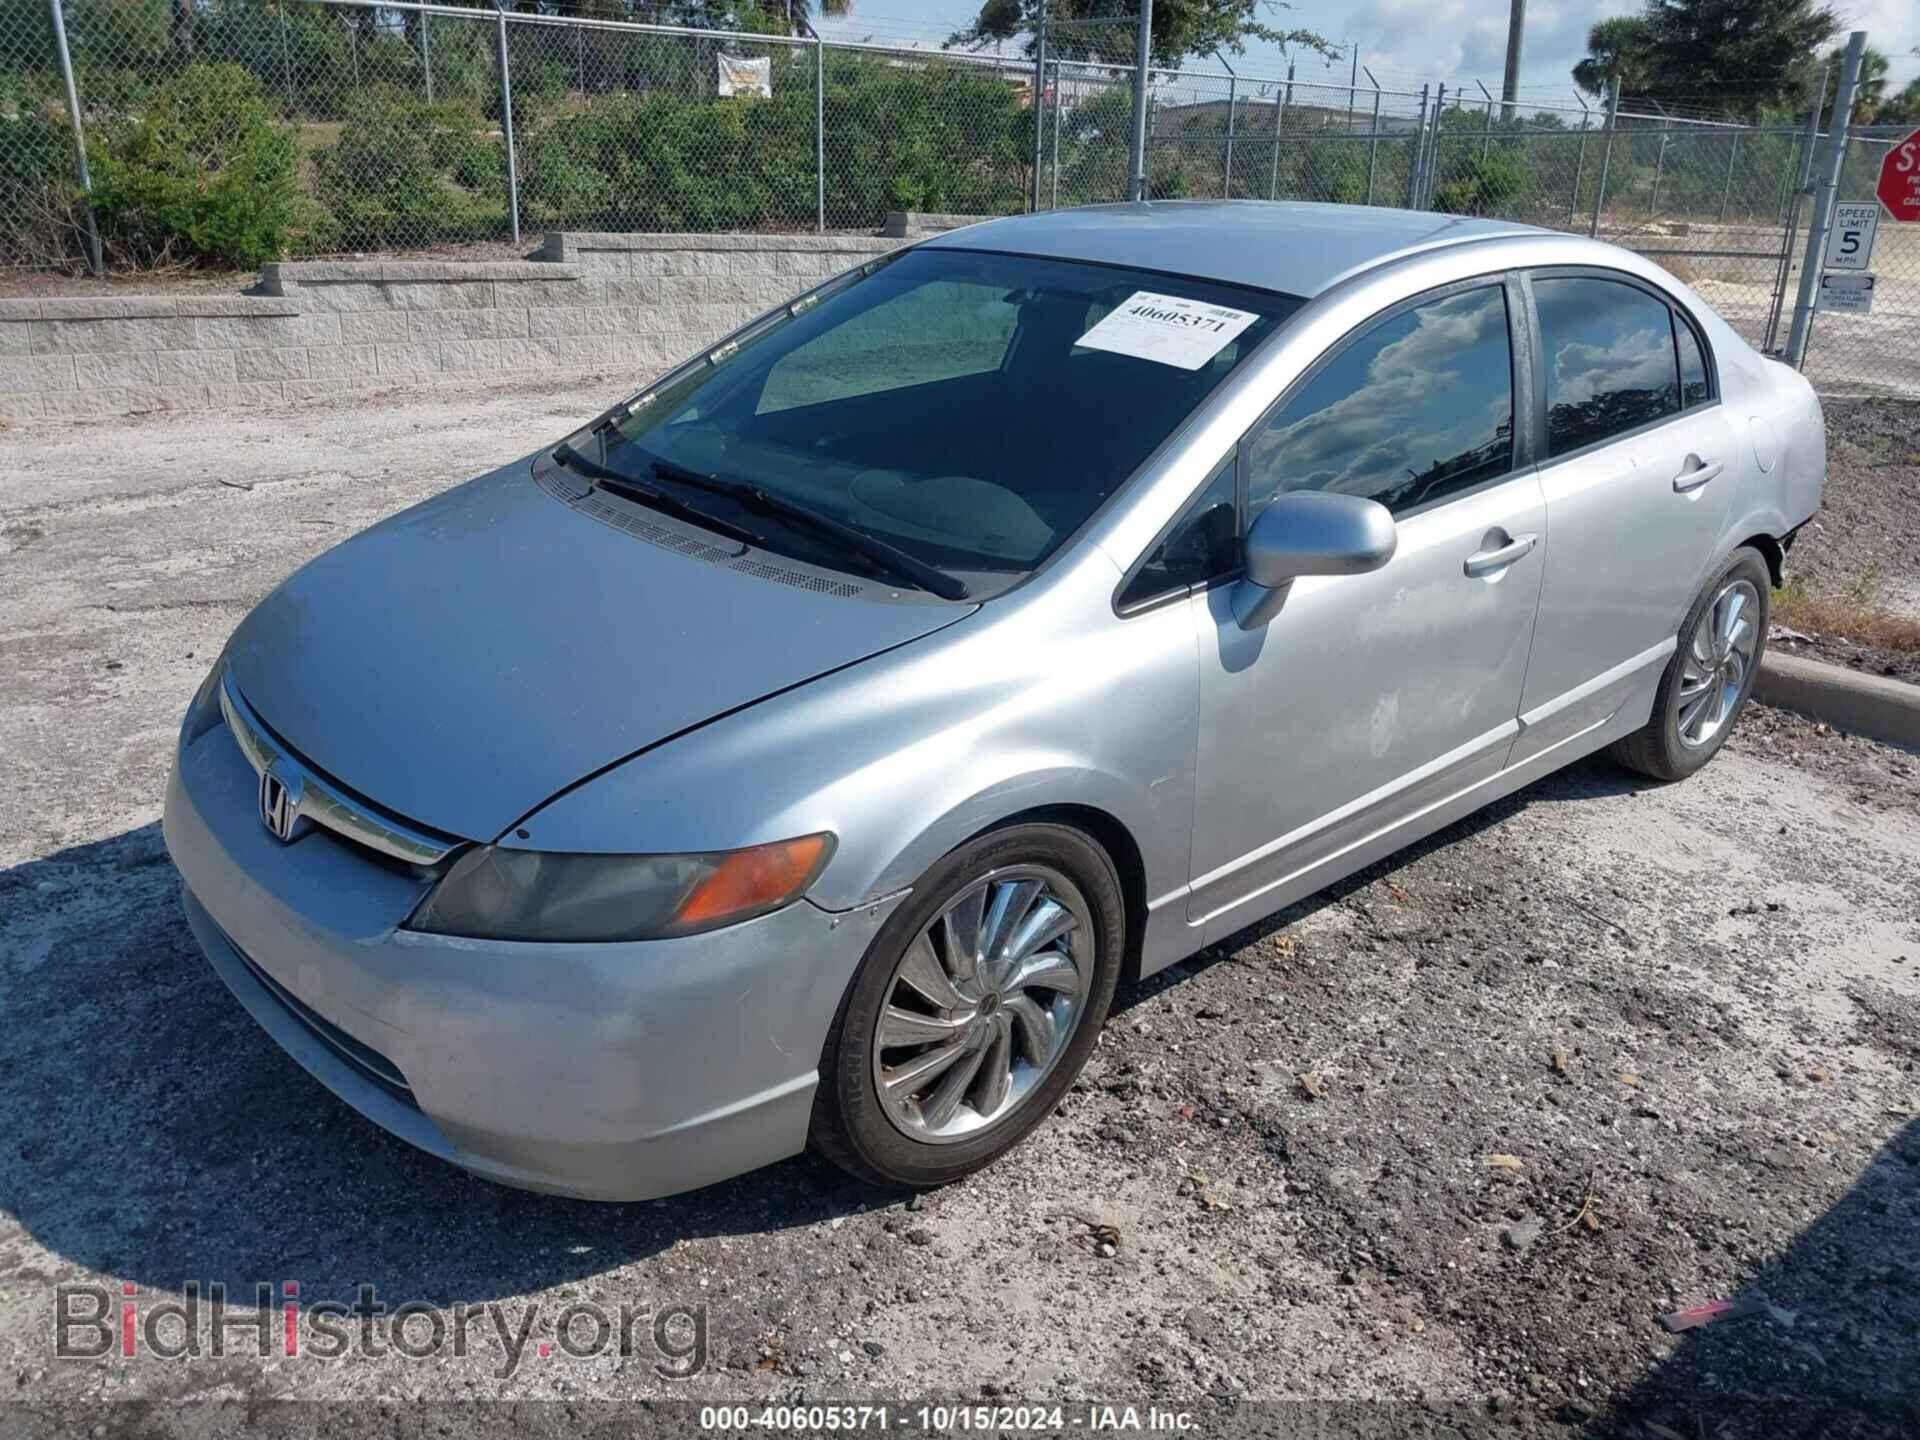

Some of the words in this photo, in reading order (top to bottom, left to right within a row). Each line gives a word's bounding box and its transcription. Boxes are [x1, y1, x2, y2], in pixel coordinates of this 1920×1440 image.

[1837, 208, 1876, 218] SPEED
[1839, 219, 1870, 229] LIMIT
[1840, 231, 1861, 254] 5
[1128, 305, 1226, 333] 40605371
